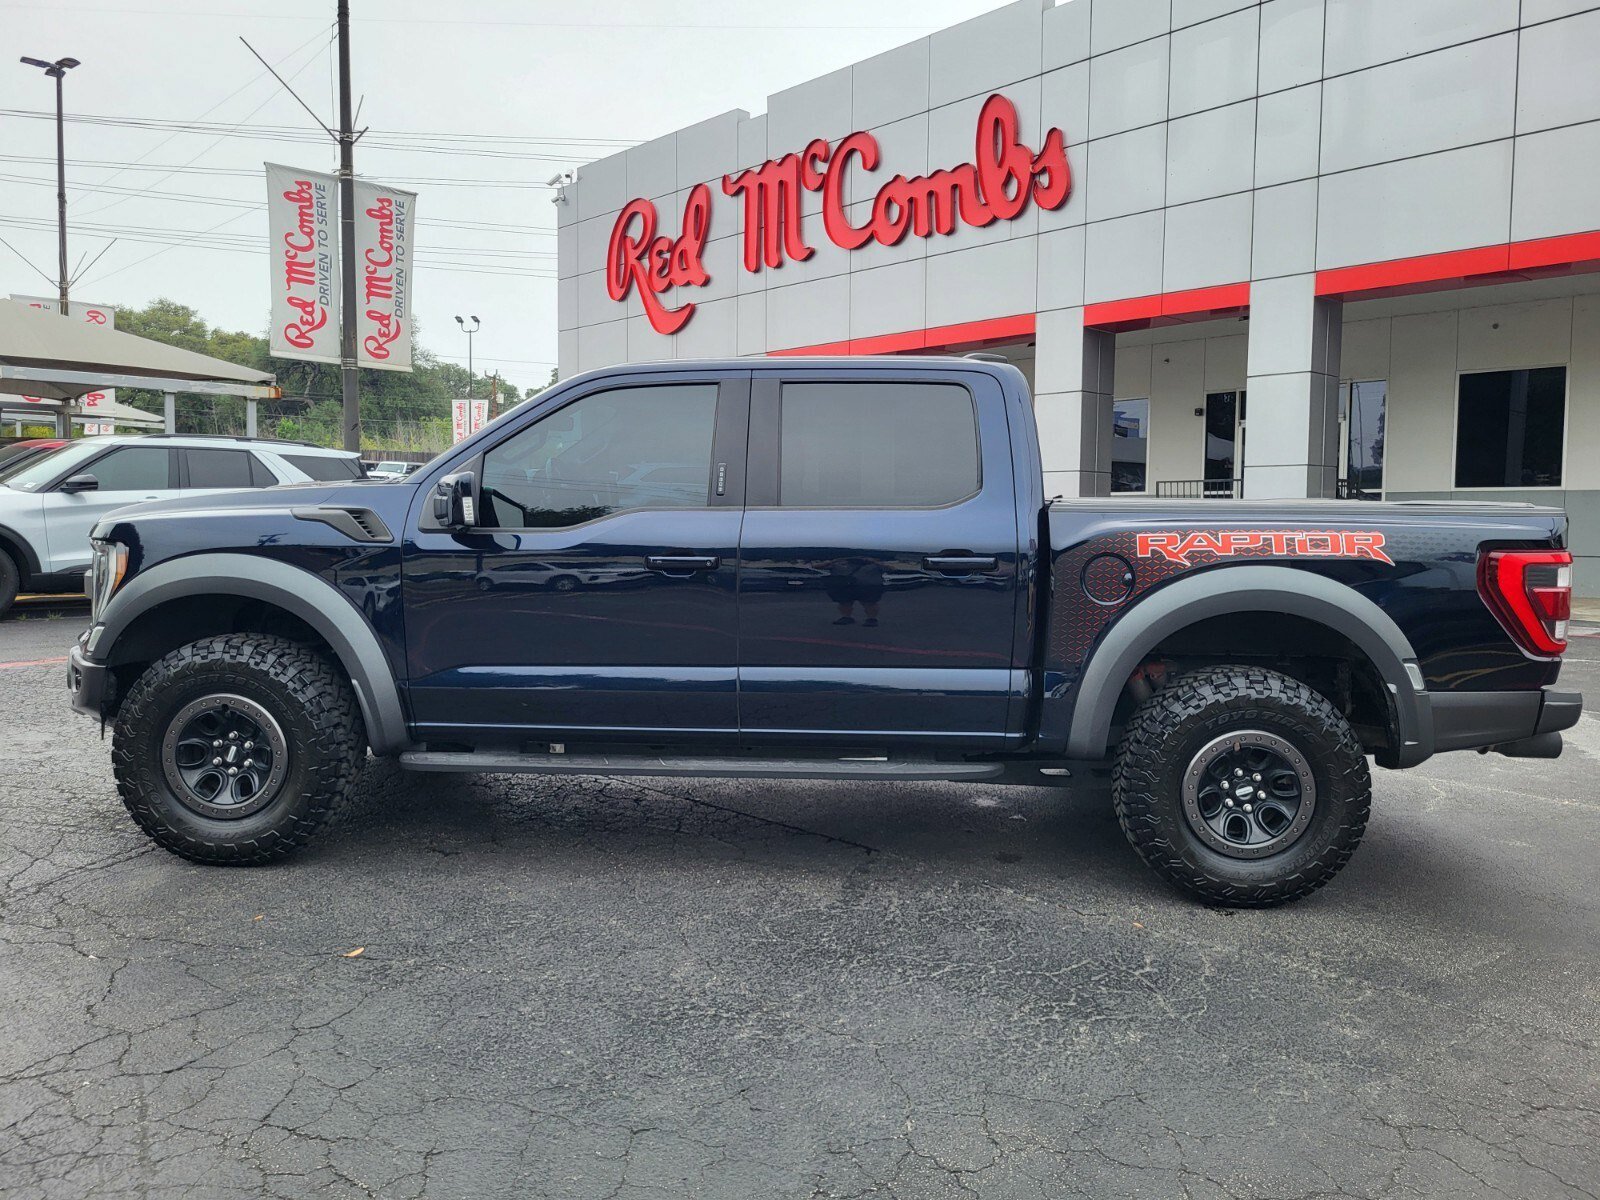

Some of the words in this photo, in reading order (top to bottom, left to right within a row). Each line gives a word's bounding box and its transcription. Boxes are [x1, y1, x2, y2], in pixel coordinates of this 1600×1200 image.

[314, 182, 328, 227] SERVE
[394, 200, 405, 241] SERVE
[606, 183, 711, 335] Red
[721, 93, 1074, 274] McCombs
[283, 180, 316, 291] McCombs
[316, 230, 328, 248] TO
[364, 197, 394, 305] McCombs
[394, 245, 405, 263] TO
[318, 252, 332, 307] DRIVEN
[394, 268, 406, 319] DRIVEN
[284, 296, 328, 349] Red
[364, 309, 400, 360] Red
[1137, 532, 1395, 567] RAPTOR
[1205, 709, 1260, 730] TOYO
